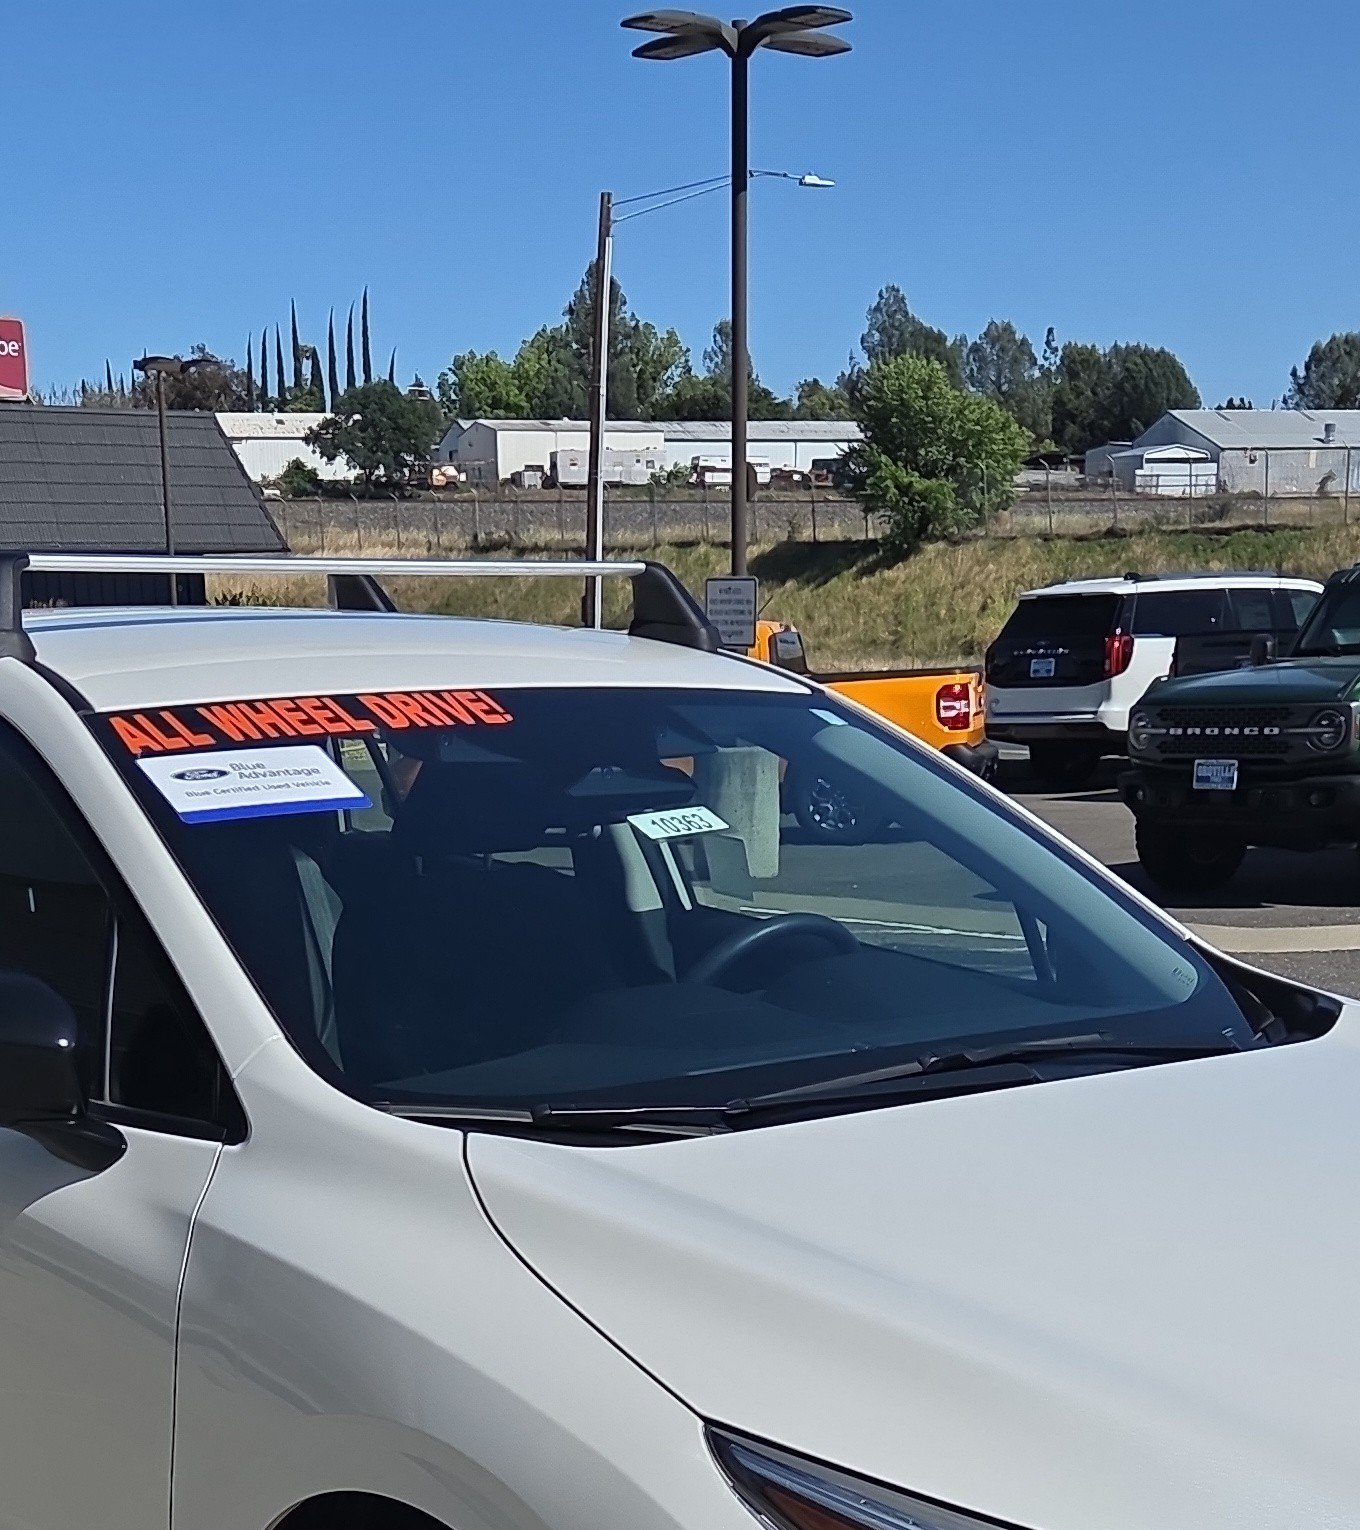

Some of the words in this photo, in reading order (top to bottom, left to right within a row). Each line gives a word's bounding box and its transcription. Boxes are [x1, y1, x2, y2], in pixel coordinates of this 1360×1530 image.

[108, 711, 218, 755] ALL
[197, 697, 379, 743] WHEEL
[356, 691, 515, 728] DRIVE!
[1169, 727, 1280, 735] BRONCO
[229, 762, 266, 771] Blue
[238, 767, 321, 780] Advantage
[213, 785, 260, 795] Certified
[261, 782, 291, 791] Used
[292, 779, 332, 788] Vehicle
[651, 813, 713, 834] 10363
